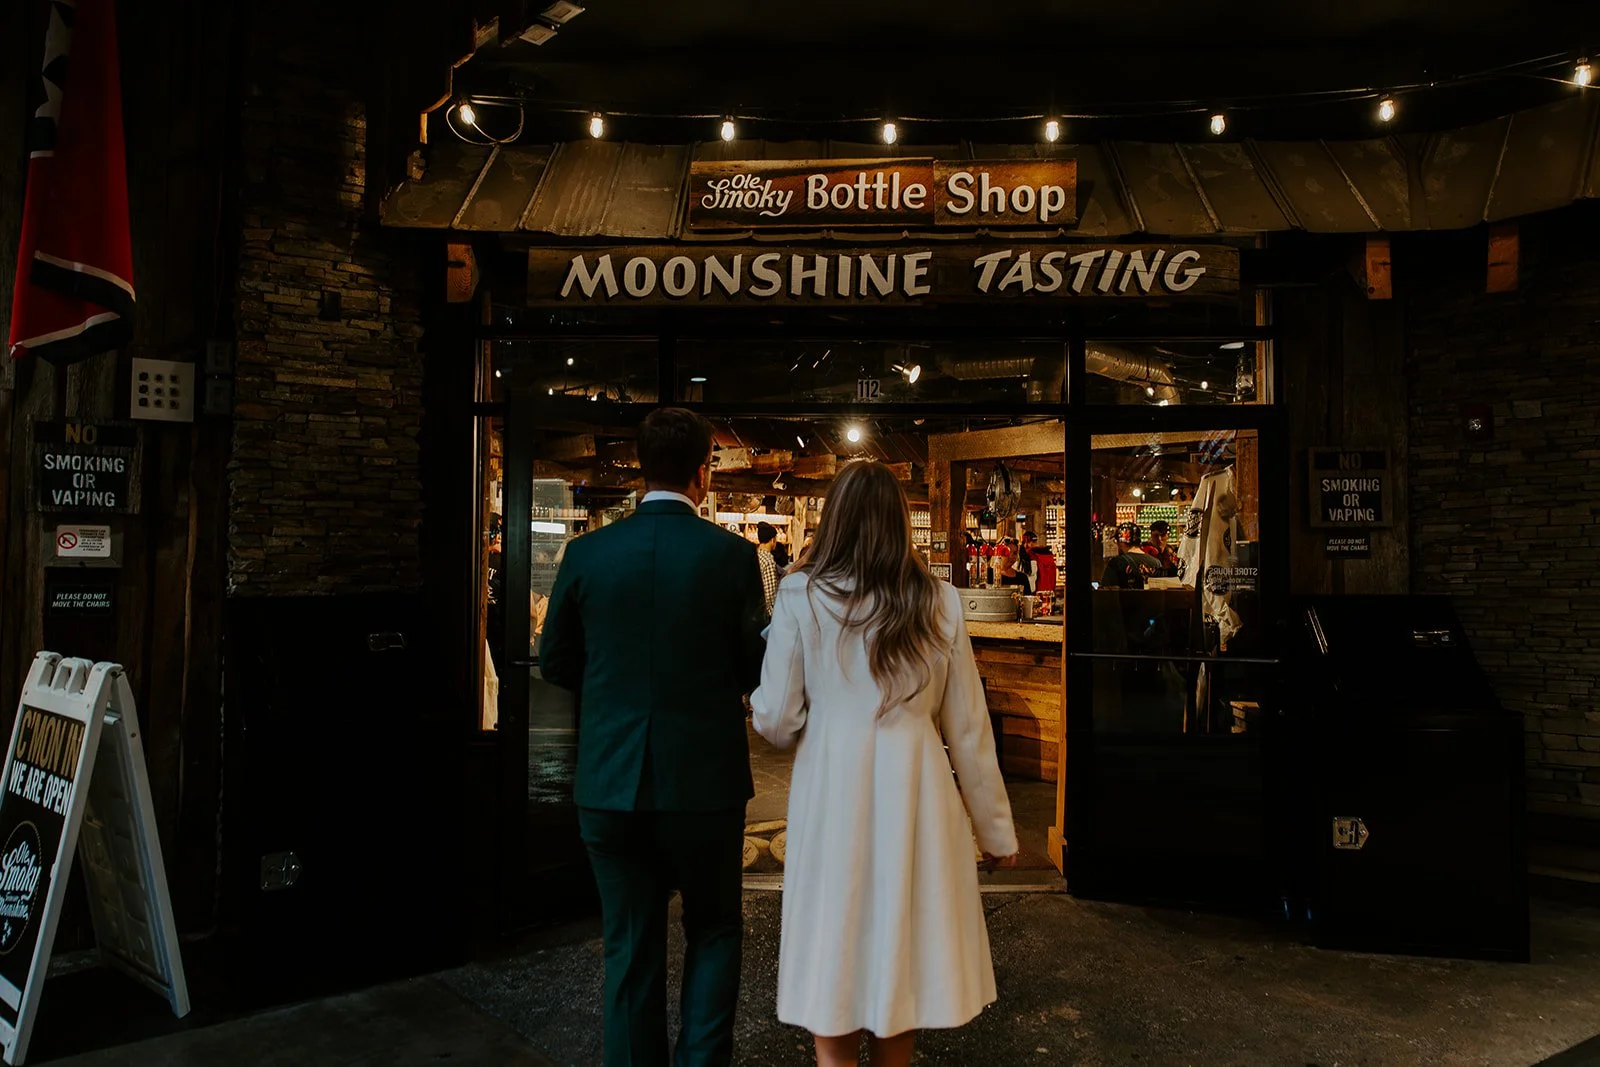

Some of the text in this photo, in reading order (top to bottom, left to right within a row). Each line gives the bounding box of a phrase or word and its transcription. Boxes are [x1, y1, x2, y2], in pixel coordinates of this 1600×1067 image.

[731, 173, 764, 191] Ole
[701, 171, 1066, 222] Smoky Bottle Shop
[560, 249, 1206, 298] MOONSHINE TASTING
[858, 380, 879, 398] 112
[65, 423, 97, 445] NO
[44, 453, 125, 474] SMOKING
[1339, 452, 1362, 471] NO
[72, 472, 96, 489] OR
[1322, 478, 1380, 492] SMOKING
[52, 488, 115, 508] VAPING
[1343, 493, 1360, 507] OR
[1328, 507, 1375, 522] VAPING
[52, 600, 110, 608] MOVE THE CHAIRS
[56, 592, 107, 600] PLEASE DO NOT
[16, 709, 67, 773] C'MON
[9, 759, 73, 817] WE ARE OPEN
[16, 840, 31, 866] Ole
[0, 847, 42, 901] Smoky
